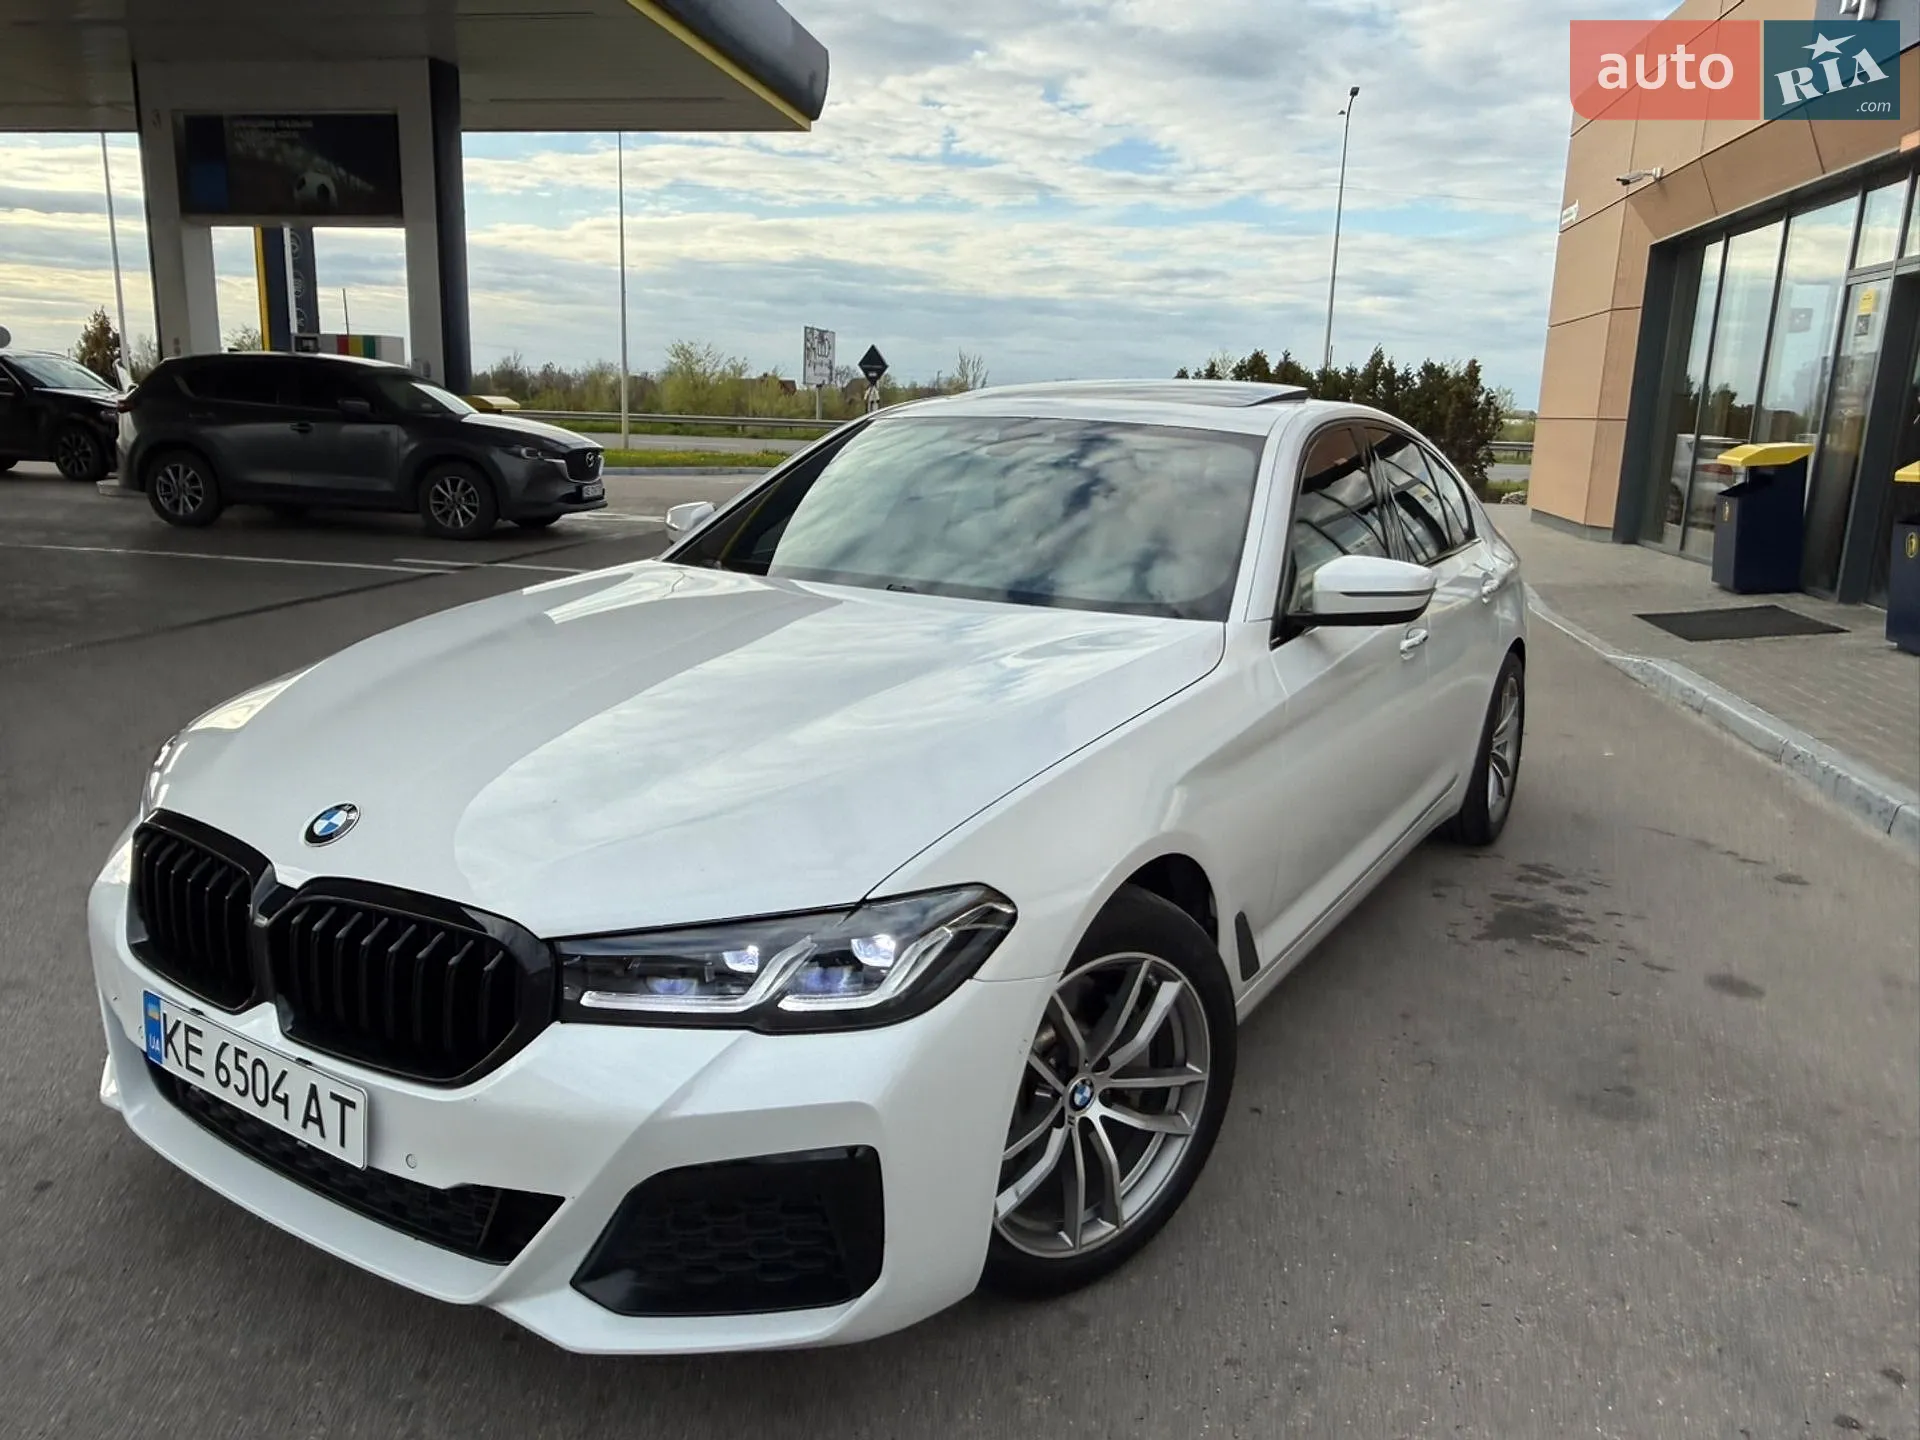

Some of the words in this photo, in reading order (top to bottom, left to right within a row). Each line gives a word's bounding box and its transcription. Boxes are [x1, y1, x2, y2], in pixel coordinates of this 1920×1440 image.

[149, 1035, 160, 1052] UA
[163, 1012, 205, 1078] KE
[214, 1041, 289, 1121] 6504
[301, 1082, 356, 1148] AT
